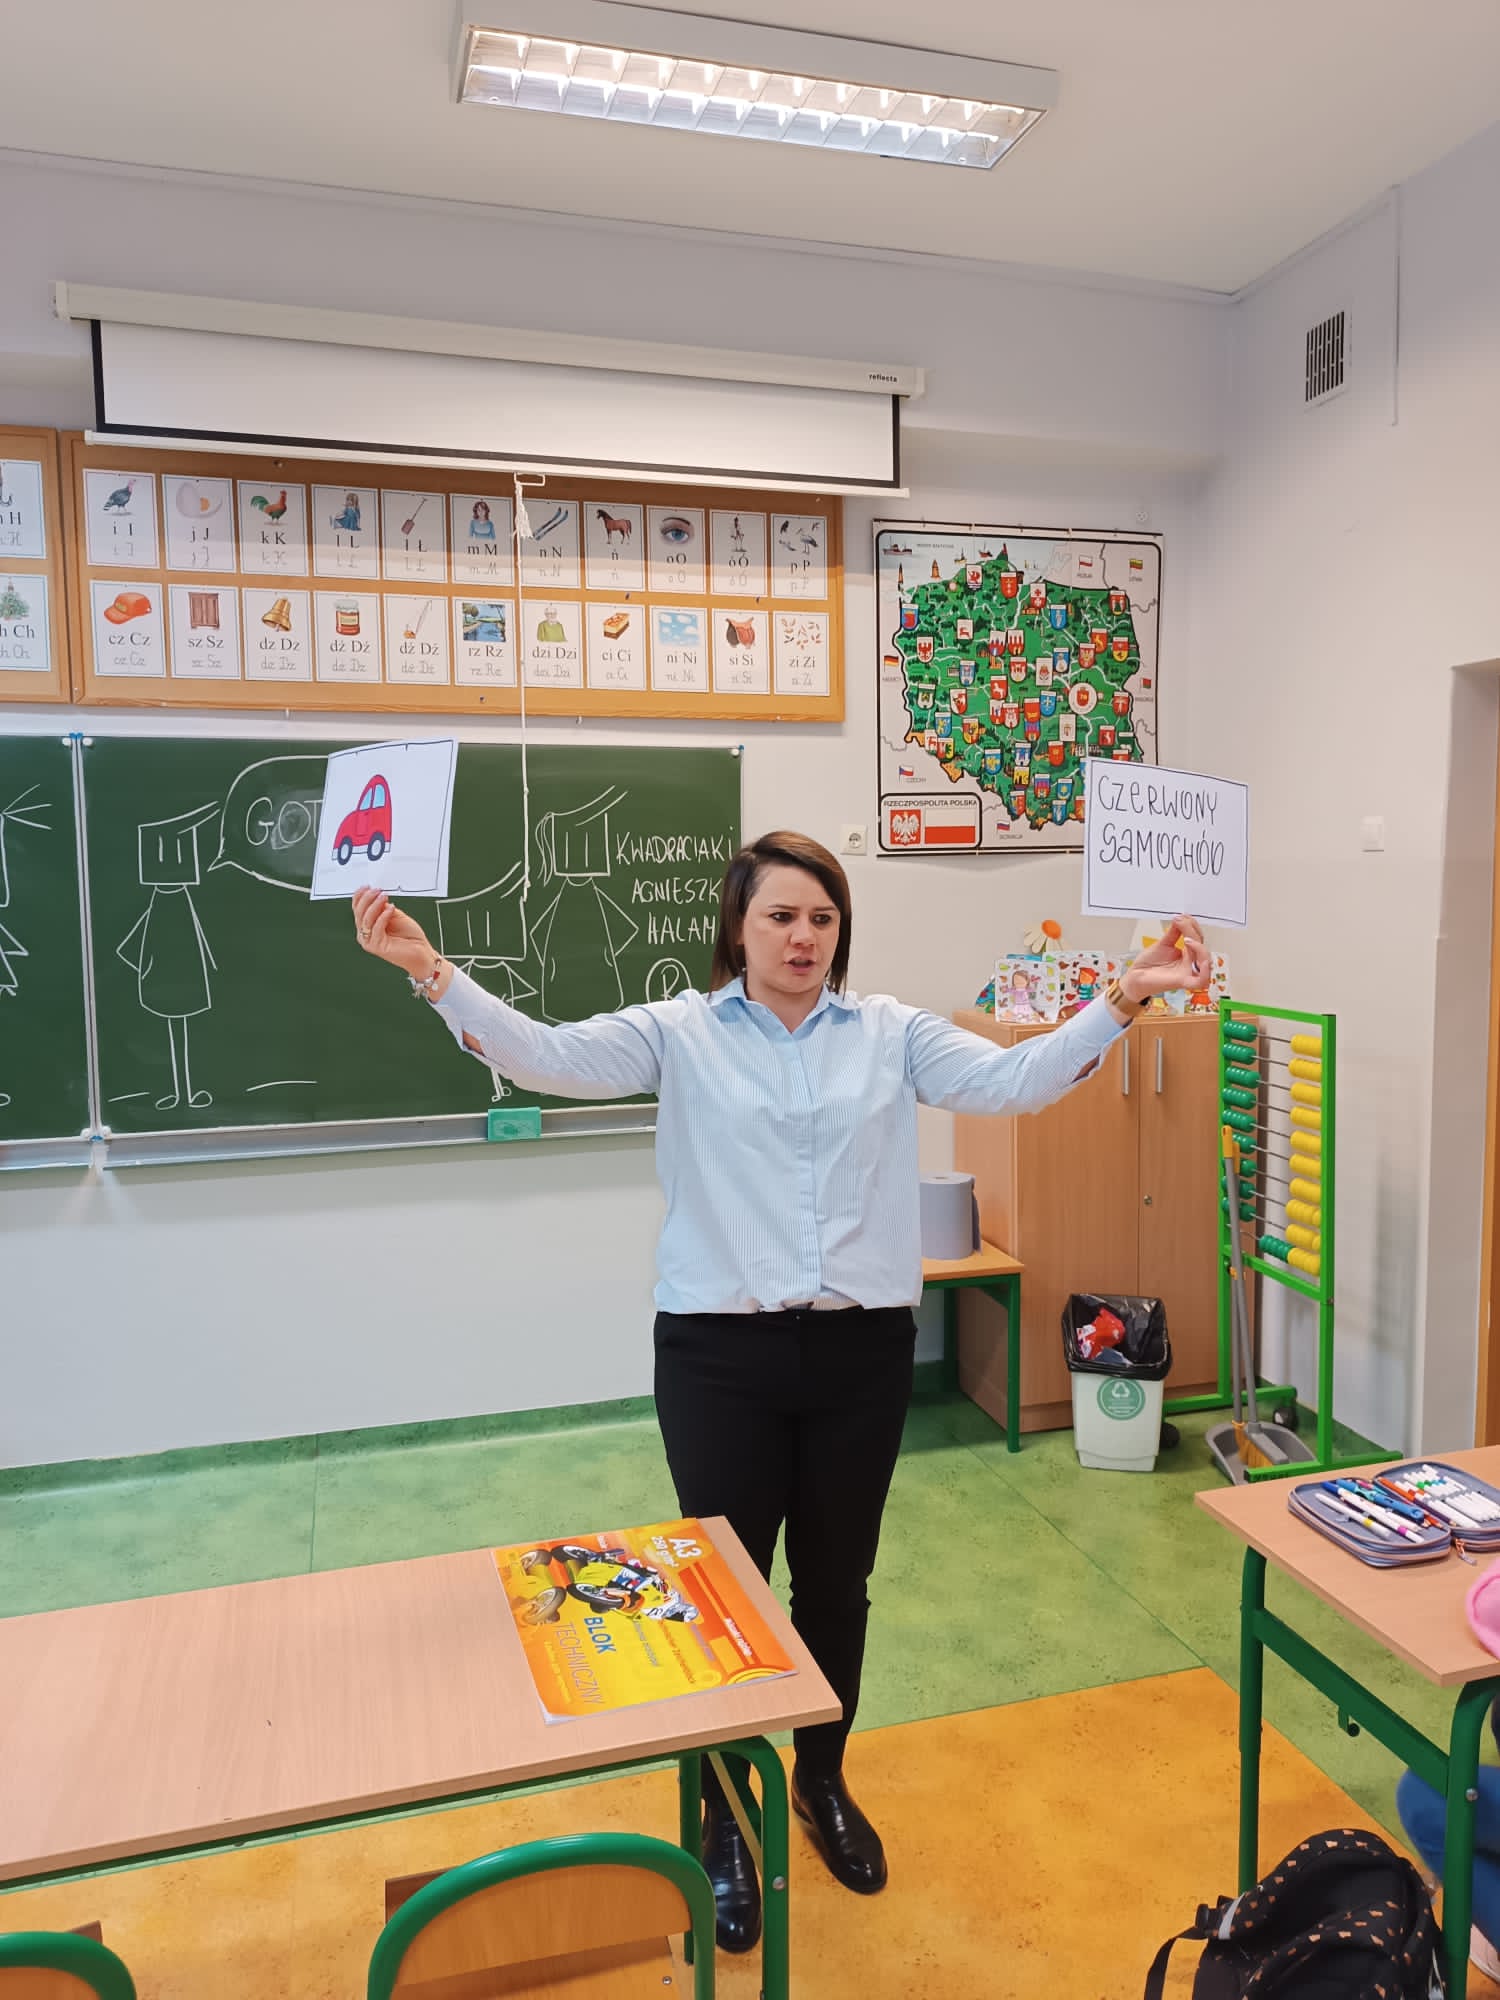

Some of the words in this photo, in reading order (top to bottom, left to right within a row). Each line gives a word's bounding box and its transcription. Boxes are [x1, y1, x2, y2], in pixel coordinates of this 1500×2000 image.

[13, 624, 35, 639] Ch
[108, 633, 126, 646] cz
[130, 632, 151, 646] Cz
[188, 638, 203, 649] sz
[206, 635, 224, 649] Sz
[259, 637, 275, 651] dz
[281, 638, 300, 651] Dz
[468, 647, 481, 658] rz
[486, 646, 503, 658] Rz
[532, 646, 550, 659] dzi
[556, 648, 577, 660] Dzi
[617, 650, 631, 663] Ci
[666, 652, 678, 664] ni
[683, 651, 697, 665] Ni
[729, 654, 739, 665] si
[742, 653, 754, 666] Si
[789, 655, 799, 667] zi
[803, 655, 815, 668] Zi
[631, 877, 722, 905] AGNIESZK
[668, 1537, 702, 1559] A3
[583, 1616, 617, 1654] BLOK
[552, 1622, 605, 1704] TECHNICZNY
